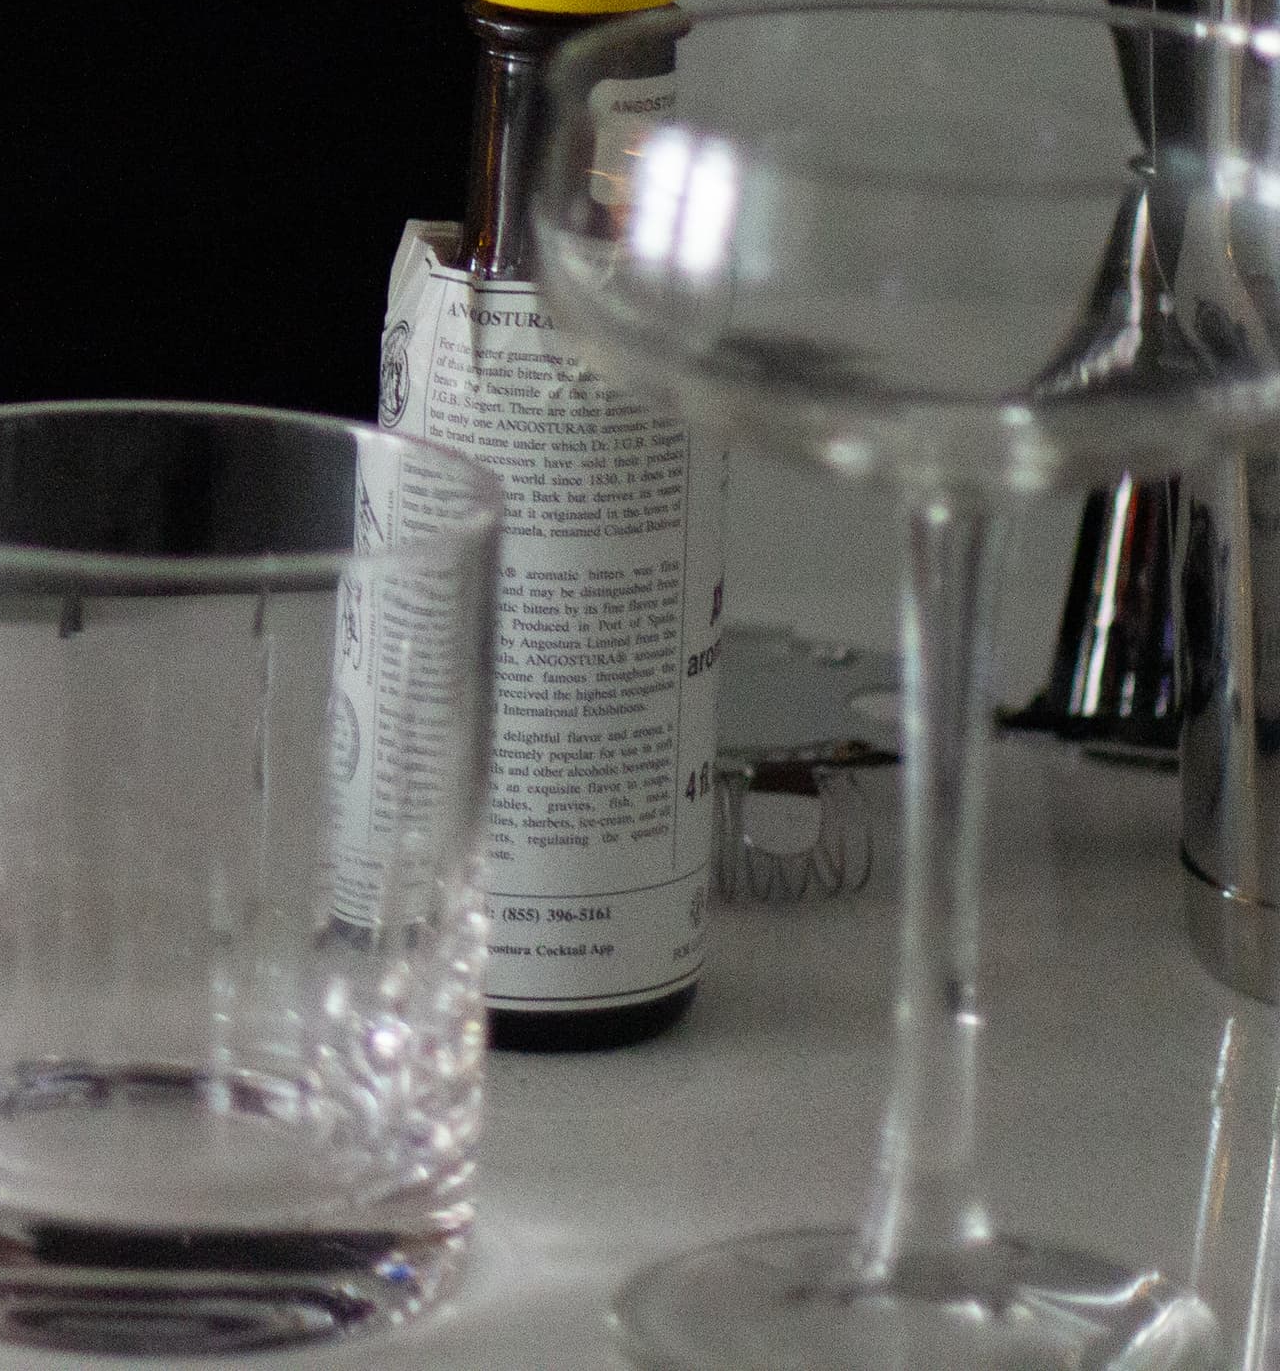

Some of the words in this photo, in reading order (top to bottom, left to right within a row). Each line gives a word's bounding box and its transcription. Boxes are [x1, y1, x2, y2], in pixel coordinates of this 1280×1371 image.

[448, 302, 555, 330] ANGOSTURA
[507, 354, 563, 366] guarantee
[517, 365, 553, 381] bitters
[486, 382, 541, 398] facsimile
[548, 387, 563, 399] of
[569, 387, 588, 400] the
[510, 401, 542, 415] There
[548, 407, 566, 416] are
[570, 406, 601, 417] other
[448, 412, 469, 425] only
[472, 418, 493, 429] one
[430, 426, 443, 437] the
[446, 428, 475, 444] brand
[479, 436, 509, 448] name
[513, 438, 547, 451] under
[551, 440, 587, 452] which
[591, 440, 609, 452] Dr.
[544, 457, 572, 469] have
[581, 456, 606, 468] sold
[614, 456, 639, 467] their
[647, 451, 684, 463] product
[511, 473, 546, 485] world
[551, 474, 583, 486] since
[589, 473, 621, 485] 1830.
[641, 469, 664, 482] does
[532, 491, 560, 502] Bark
[567, 490, 586, 502] but
[593, 490, 634, 501] derives
[639, 487, 652, 499] its
[658, 484, 682, 496] name
[528, 507, 536, 518] it
[541, 506, 602, 522] originated
[607, 507, 618, 518] in
[623, 505, 640, 517] the
[644, 503, 669, 513] town
[672, 499, 682, 511] of
[550, 526, 601, 537] renamed
[526, 569, 580, 581] aromatic
[588, 568, 624, 580] bitters
[633, 566, 654, 576] was
[661, 561, 679, 572] first
[502, 586, 524, 597] and
[529, 588, 554, 600] may
[560, 586, 575, 598] be
[580, 582, 652, 599] distinguished
[657, 578, 678, 590] from
[522, 603, 560, 615] bitters
[565, 603, 579, 617] by
[584, 604, 599, 614] its
[603, 602, 624, 613] fine
[628, 598, 658, 612] flavor
[662, 594, 678, 605] and
[512, 619, 570, 632] Produced
[578, 620, 590, 631] in
[598, 618, 622, 631] Port
[629, 616, 641, 628] of
[500, 636, 514, 648] by
[521, 638, 581, 650] Angostura
[586, 637, 630, 649] Limited
[636, 633, 659, 644] from
[663, 629, 676, 640] the
[634, 647, 676, 661] aromatic
[542, 671, 588, 683] famous
[595, 667, 655, 682] throughout
[661, 663, 676, 674] the
[498, 687, 549, 700] received
[553, 689, 571, 700] the
[575, 688, 617, 702] highest
[621, 680, 675, 698] recognition
[503, 704, 578, 718] International
[503, 730, 561, 745] delightful
[567, 731, 603, 743] flavor
[608, 729, 628, 741] and
[549, 749, 593, 762] popular
[599, 747, 615, 759] for
[621, 746, 638, 757] use
[642, 744, 652, 753] in
[508, 765, 529, 777] and
[533, 766, 563, 777] other
[567, 765, 618, 777] alcoholic
[506, 784, 521, 792] an
[527, 783, 581, 796] exquisite
[587, 781, 621, 794] flavor
[627, 780, 638, 790] in
[547, 801, 596, 814] gravies,
[609, 797, 634, 809] fish,
[522, 817, 575, 829] sherbets,
[638, 810, 656, 821] and
[660, 805, 670, 817] all
[527, 834, 590, 847] regulating
[601, 833, 620, 843] the
[502, 907, 540, 924] (855)
[546, 907, 612, 922] 396-5161
[536, 944, 586, 957] Cocktail
[590, 943, 615, 956] App
